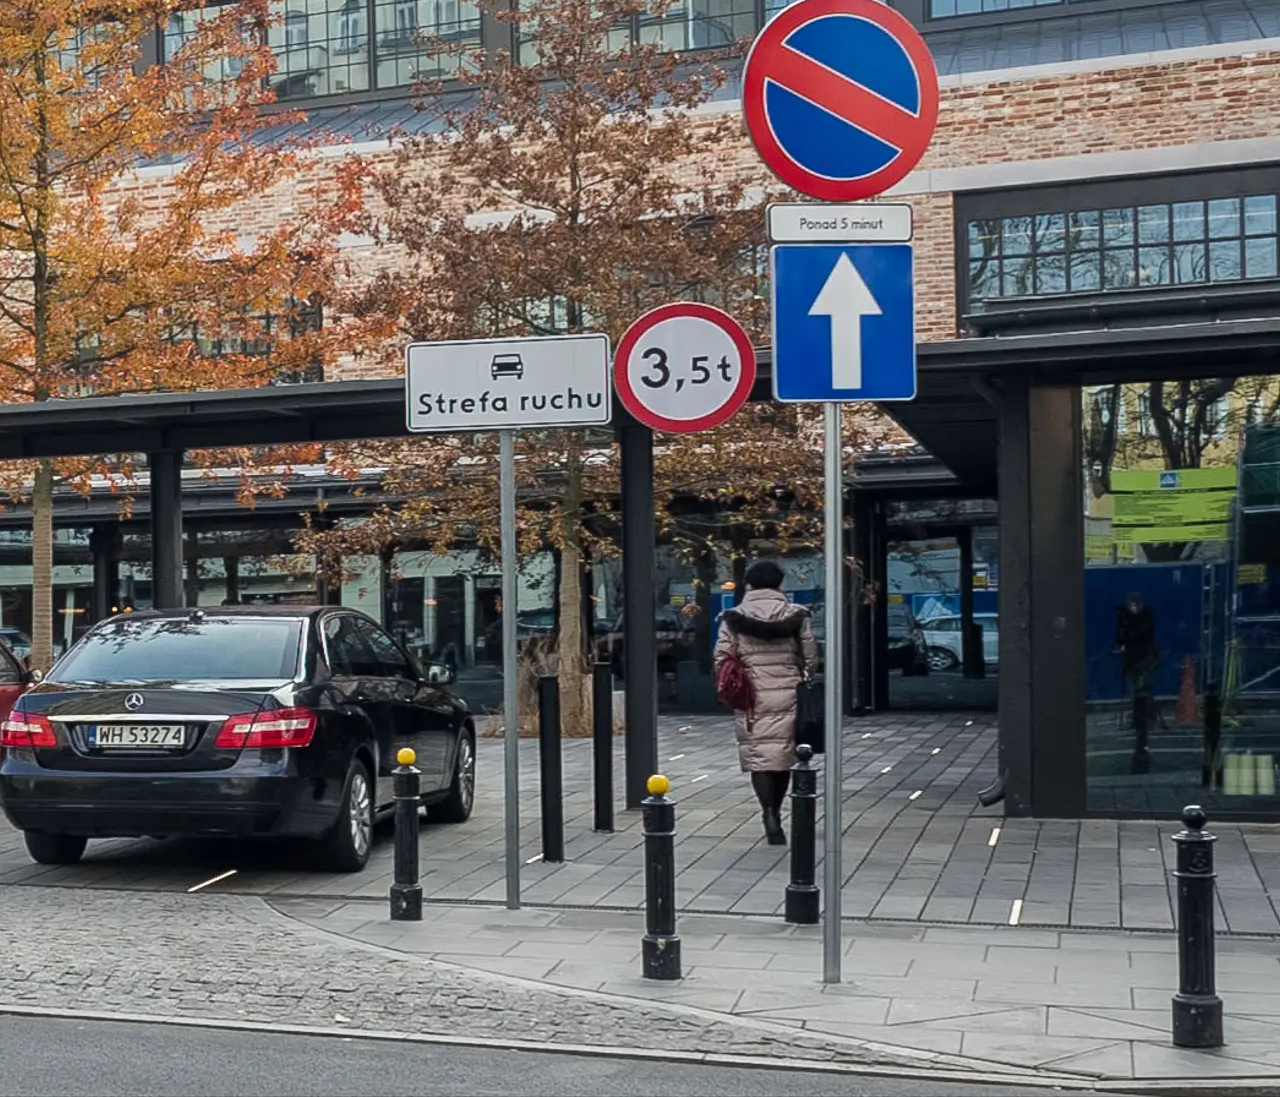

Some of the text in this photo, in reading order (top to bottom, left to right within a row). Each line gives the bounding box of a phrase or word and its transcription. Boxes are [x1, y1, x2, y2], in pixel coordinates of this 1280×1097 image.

[799, 217, 883, 230] Ponad 5 minut
[418, 387, 602, 415] Strefa ruchu
[99, 727, 181, 743] WH 53274
